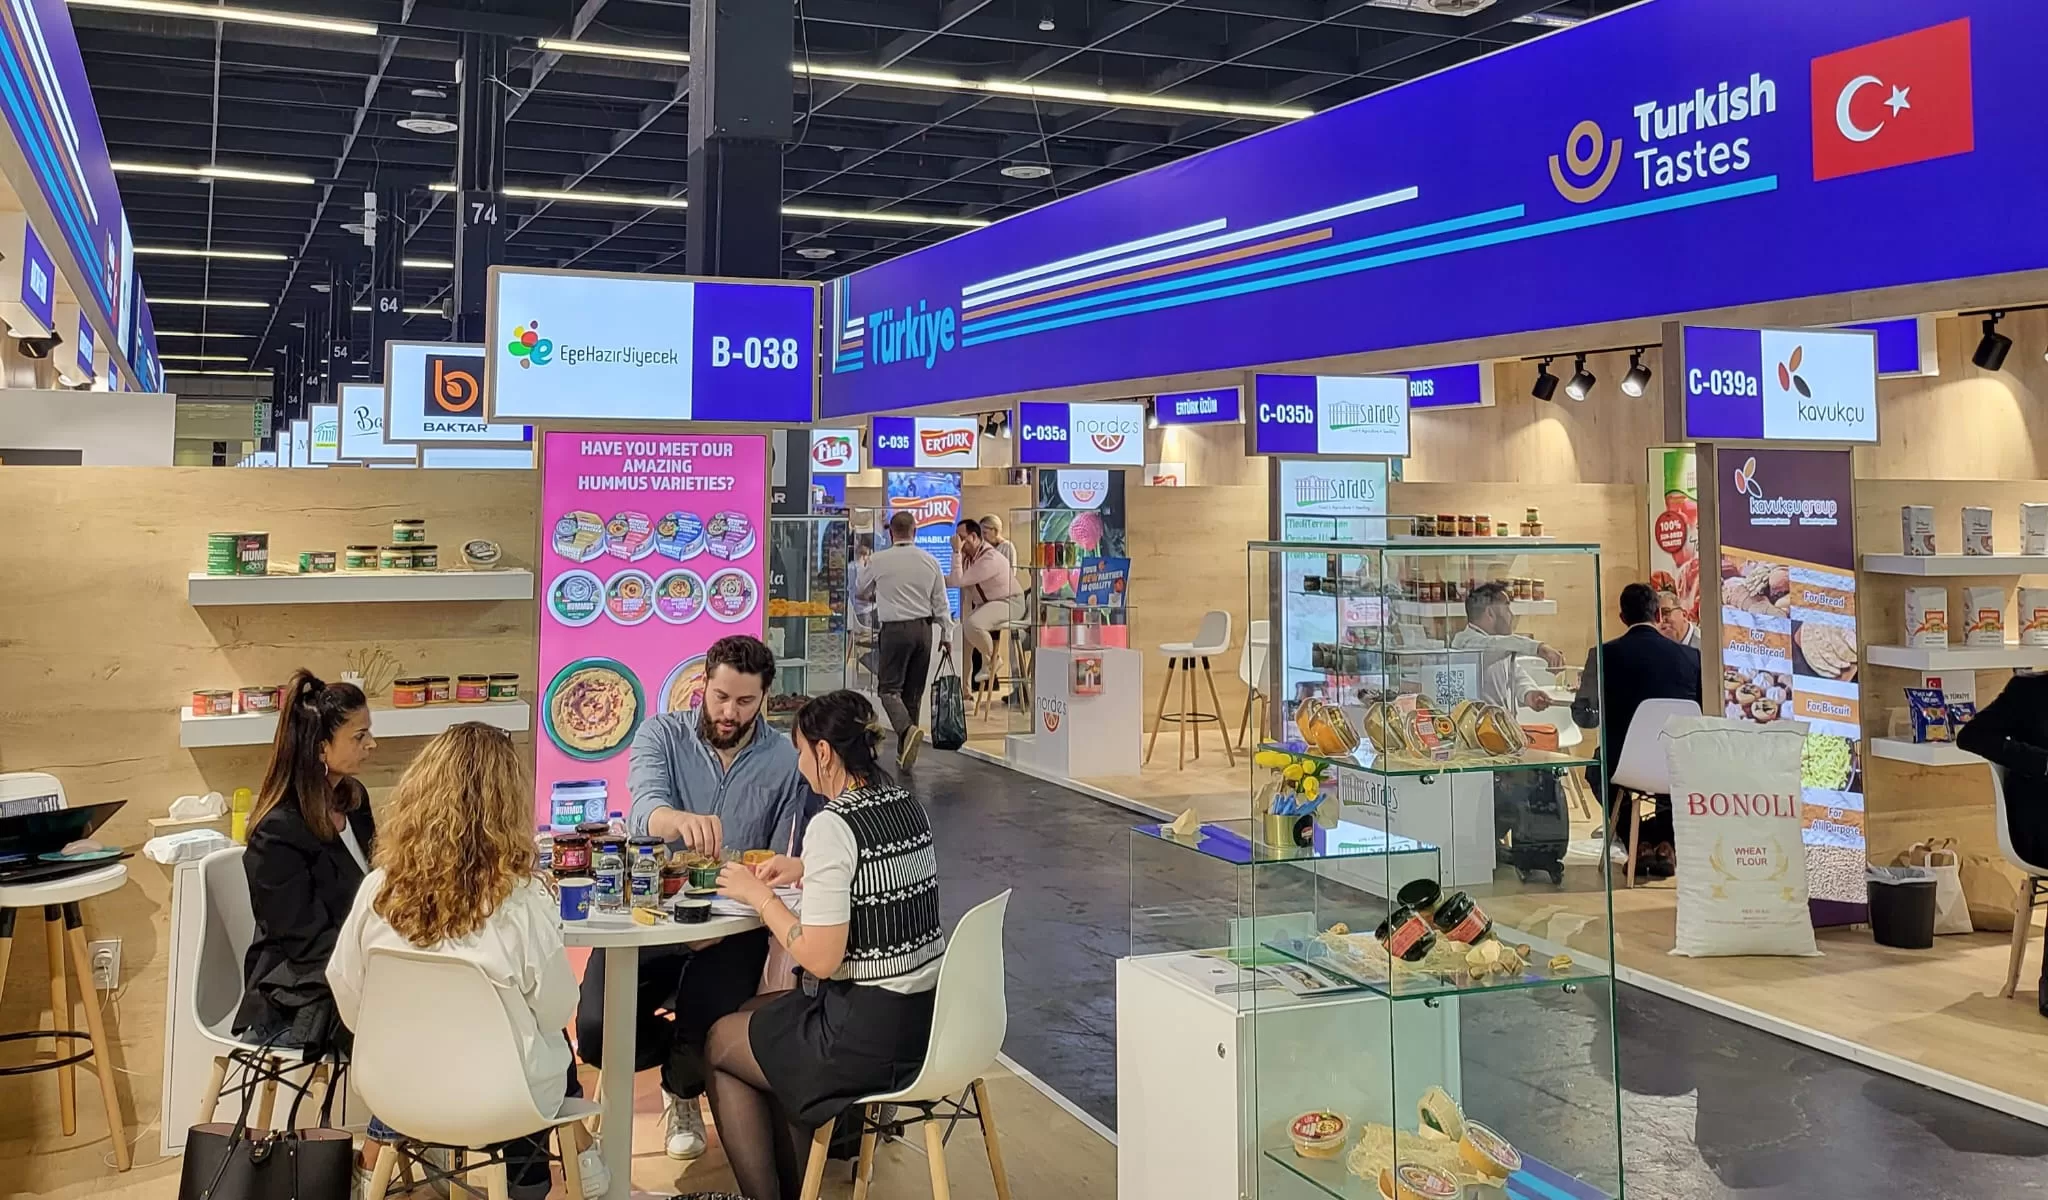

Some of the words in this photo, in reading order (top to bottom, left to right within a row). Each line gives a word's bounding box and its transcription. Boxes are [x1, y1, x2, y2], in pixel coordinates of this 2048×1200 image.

[1634, 72, 1776, 144] Turkish
[1634, 136, 1751, 190] Tastes
[471, 202, 498, 225] 74
[380, 297, 398, 313] 64
[869, 299, 956, 370] Türkiye
[333, 346, 348, 358] 54
[711, 335, 799, 369] B-038
[306, 376, 318, 386] 44
[1689, 368, 1758, 398] C-039a
[288, 395, 298, 404] 34
[1259, 403, 1314, 424] C-035b
[1798, 401, 1865, 427] kavukçu
[423, 422, 488, 433] BAKTAR
[1022, 424, 1067, 441] C-035a
[1076, 415, 1139, 435] nordes
[580, 440, 623, 456] HAVE
[625, 441, 657, 457] YOU
[659, 442, 699, 457] MEET
[701, 442, 733, 457] OUR
[878, 435, 910, 449] C-035
[622, 458, 693, 474] AMAZING
[577, 475, 648, 491] HUMMUS
[650, 476, 735, 491] VARIETIES?
[1062, 477, 1105, 492] nordes
[1749, 496, 1801, 517] kavukçu
[1801, 499, 1837, 518] group
[1660, 520, 1681, 532] 100%
[1803, 591, 1819, 603] For
[1819, 594, 1845, 608] Bread
[1750, 629, 1765, 641] For
[1729, 640, 1759, 655] Arabic
[1759, 643, 1786, 659] Bread
[1036, 695, 1068, 716] nordes
[1806, 700, 1820, 711] For
[1821, 702, 1850, 716] Biscuit
[1688, 791, 1797, 819] BONOLI
[1828, 807, 1842, 818] For
[1825, 822, 1859, 837] Purpose
[1734, 847, 1768, 857] WHEAT
[1736, 857, 1768, 866] FLOUR
